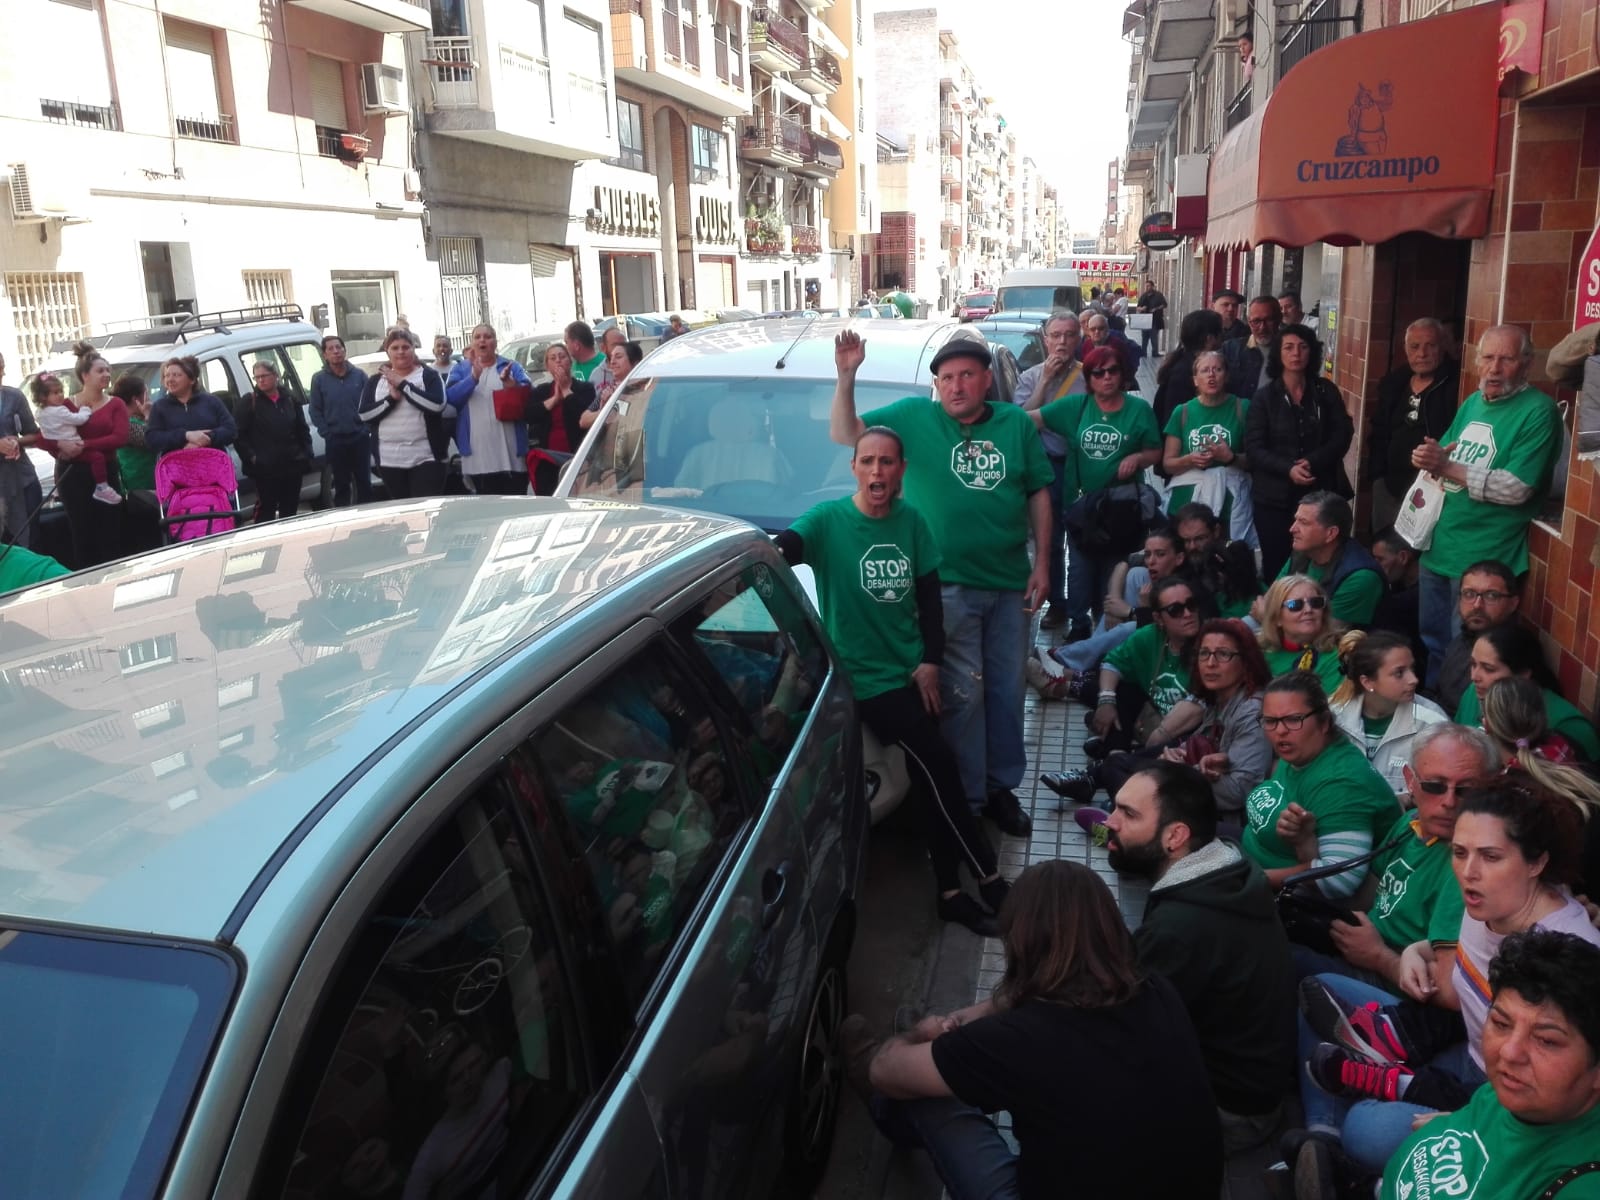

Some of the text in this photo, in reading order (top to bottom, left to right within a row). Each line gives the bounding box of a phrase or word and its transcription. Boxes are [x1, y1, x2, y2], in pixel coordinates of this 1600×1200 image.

[1297, 155, 1440, 183] Cruzcampo
[596, 186, 661, 230] MUEBLES
[1084, 430, 1119, 444] STOP
[956, 464, 1001, 480] DESUCIOS
[865, 559, 908, 578] STOP
[1430, 1136, 1469, 1196] STOP
